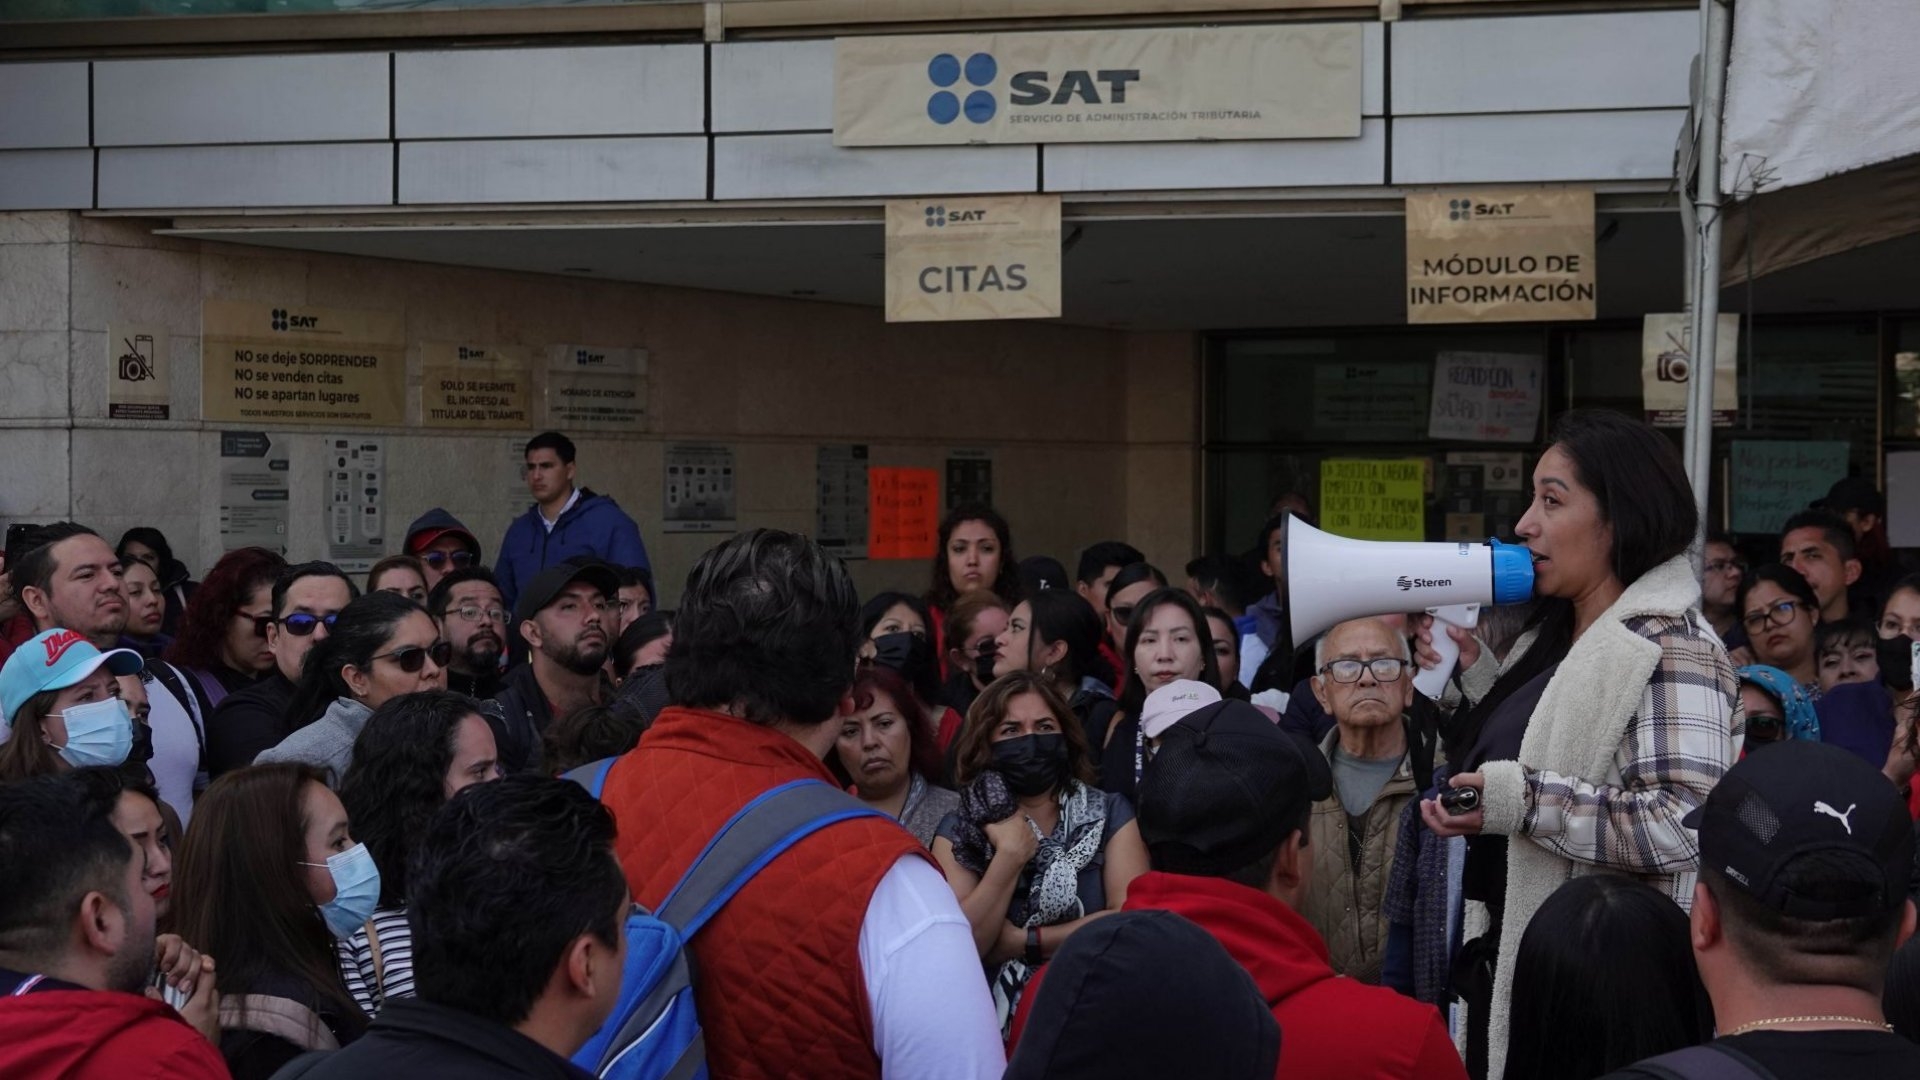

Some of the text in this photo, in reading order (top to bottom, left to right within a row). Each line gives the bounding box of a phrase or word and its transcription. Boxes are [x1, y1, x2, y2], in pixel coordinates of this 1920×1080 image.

[1010, 70, 1140, 106] SAT
[1009, 109, 1262, 124] SERVICIO DE ADMINISTRACIÓN TRIBUTARIA
[948, 210, 986, 222] SAT
[1475, 203, 1515, 216] SAT
[1424, 253, 1580, 277] MÓDULO DE
[918, 263, 1028, 294] CITAS
[1411, 280, 1595, 305] INFORMACIÓN
[290, 315, 318, 328] SAT
[235, 351, 377, 369] NO se deje SORPRENDER
[469, 350, 485, 358] SAT
[588, 354, 606, 363] SAT
[235, 369, 344, 385] NO se venden citas
[440, 380, 517, 393] SOLO SE PERMITE
[235, 387, 360, 405] NO se apartan lugares
[446, 395, 511, 406] EL INGRESO AL
[240, 409, 262, 417] TODOS
[262, 410, 294, 418] NUESTROS
[295, 410, 326, 418] SERVICIOS
[327, 411, 339, 419] SON
[431, 409, 525, 421] TITULAR DEL TRÁMITE
[1322, 463, 1334, 477] LA
[1325, 480, 1387, 496] EMPIEZA CON
[1325, 496, 1420, 514] RESPETO Y TERMINA
[1330, 512, 1418, 531] CON DIGNIDAD
[1414, 578, 1452, 588] Steren
[1136, 731, 1144, 747] SAT
[1135, 753, 1143, 770] SAT
